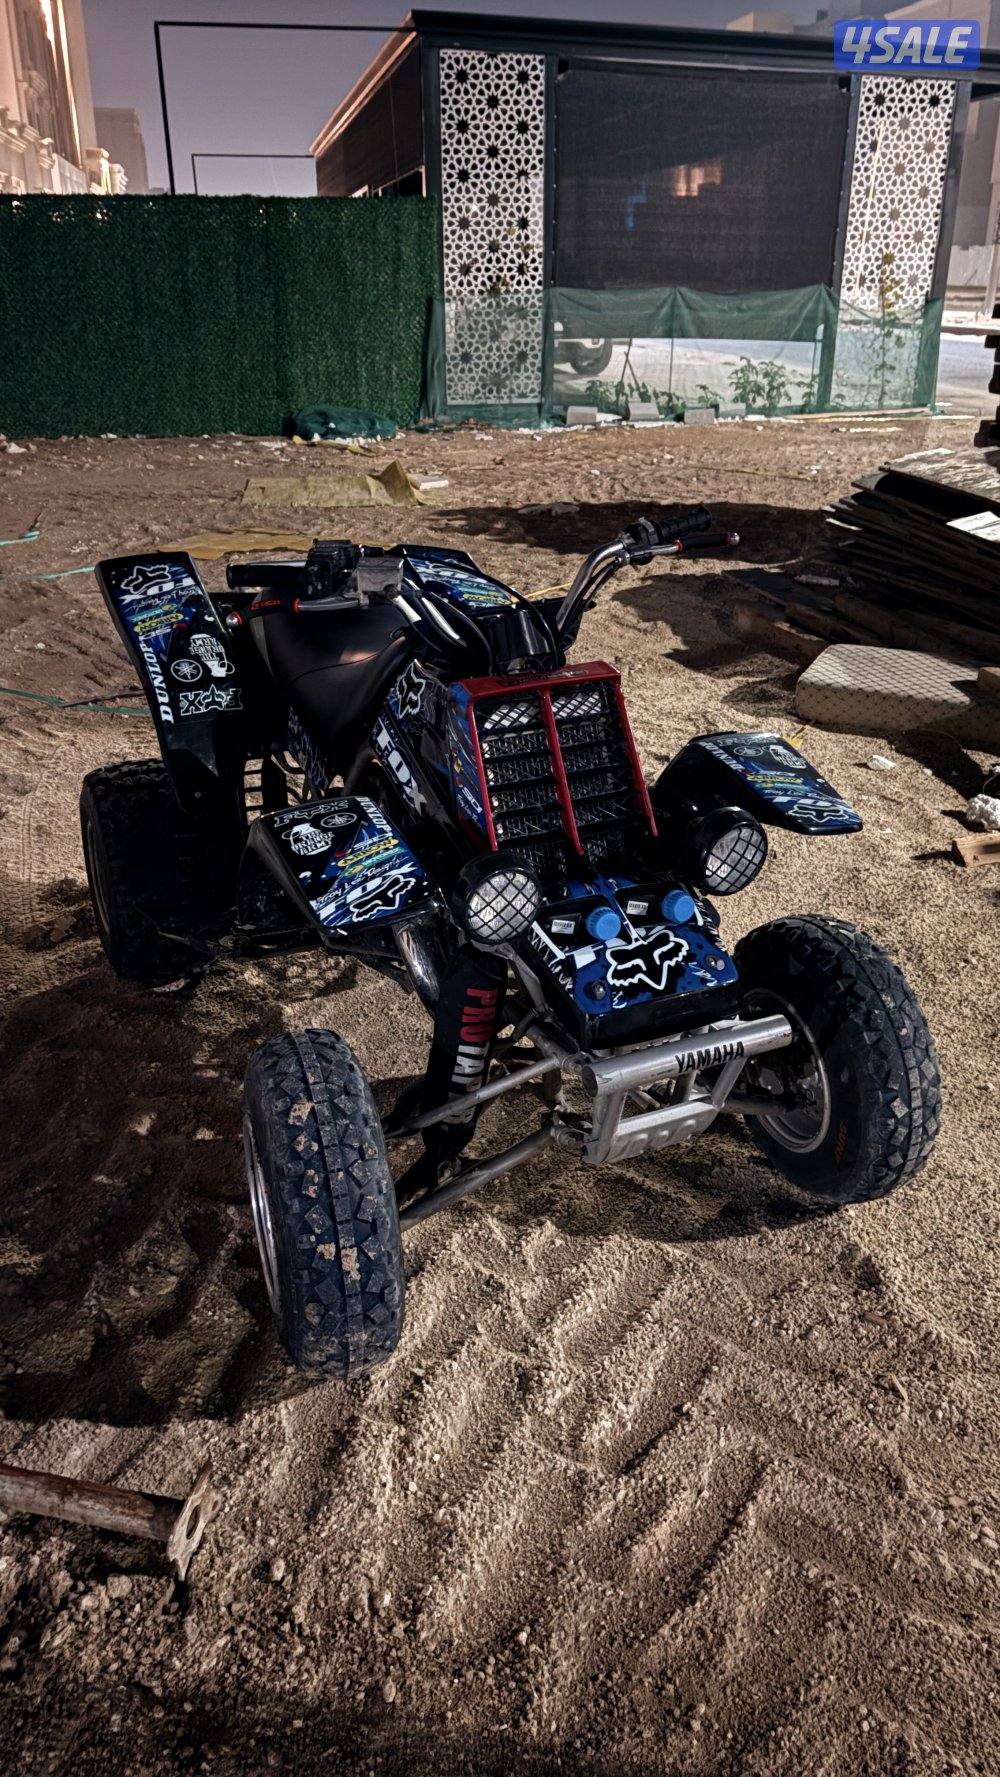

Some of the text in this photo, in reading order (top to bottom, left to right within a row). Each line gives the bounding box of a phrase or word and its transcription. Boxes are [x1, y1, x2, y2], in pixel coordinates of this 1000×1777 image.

[118, 577, 196, 605] FOX
[140, 640, 174, 724] DUNLOP
[377, 716, 428, 816] FOX
[355, 797, 393, 837] DUNLOP
[317, 861, 418, 920] FOX
[675, 1041, 745, 1073] YAMAHA
